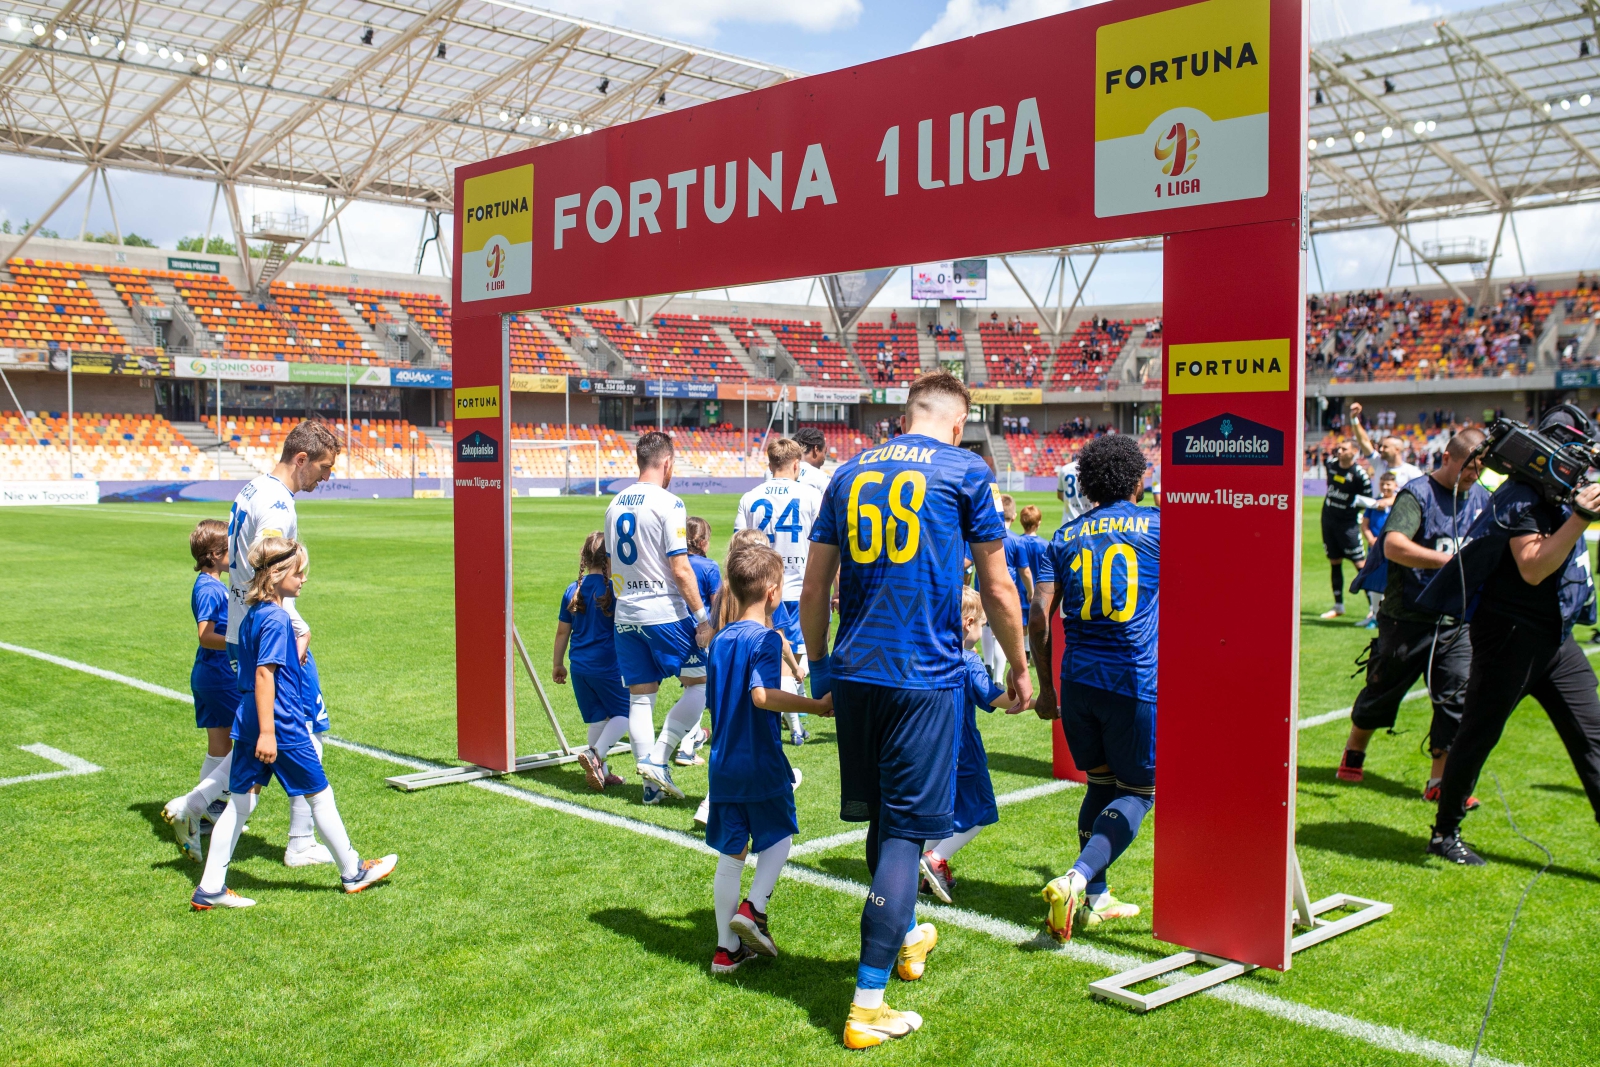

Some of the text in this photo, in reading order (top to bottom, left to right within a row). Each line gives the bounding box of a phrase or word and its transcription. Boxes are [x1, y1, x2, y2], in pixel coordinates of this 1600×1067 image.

[1106, 42, 1258, 94] FORTUNA
[554, 97, 1050, 250] FORTUNA 1 LIGA
[1154, 179, 1200, 198] 1 LIGA
[467, 196, 528, 223] FORTUNA
[486, 280, 505, 292] 1 LIGA
[1176, 358, 1281, 376] FORTUNA
[458, 397, 497, 408] FORTUNA
[462, 444, 494, 458] Zakopiańska
[858, 444, 937, 465] CZUBAK
[1185, 436, 1270, 457] Zakopiańska
[456, 477, 501, 489] www.1liga.org
[765, 486, 790, 494] SITEK
[4, 492, 24, 500] Nie
[42, 491, 88, 502] Toyocie!
[616, 494, 645, 506] JANOTA
[1166, 489, 1288, 510] www.1liga.org
[750, 498, 803, 543] 24
[847, 470, 927, 564] 68
[616, 512, 638, 566] 8
[1064, 517, 1150, 542] C. ALEMAN
[627, 580, 664, 590] SAFETY
[1070, 543, 1139, 623] 10
[868, 892, 886, 907] AG
